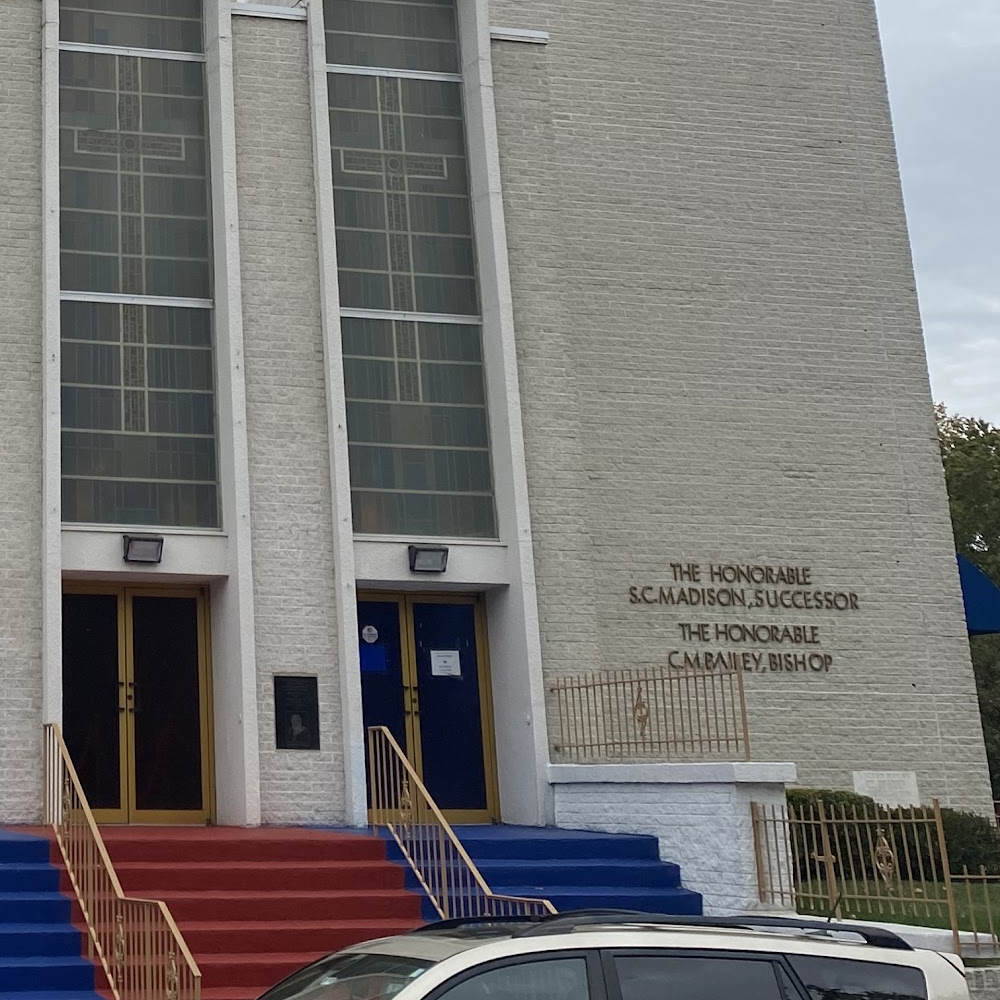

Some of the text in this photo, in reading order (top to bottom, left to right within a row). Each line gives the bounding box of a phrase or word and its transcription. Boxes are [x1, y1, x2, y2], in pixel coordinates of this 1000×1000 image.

[670, 563, 812, 586] THE HONORABLE
[754, 589, 860, 611] SUCCESSOR
[678, 622, 820, 645] THE HONORABLE
[768, 652, 833, 673] BISHOP
